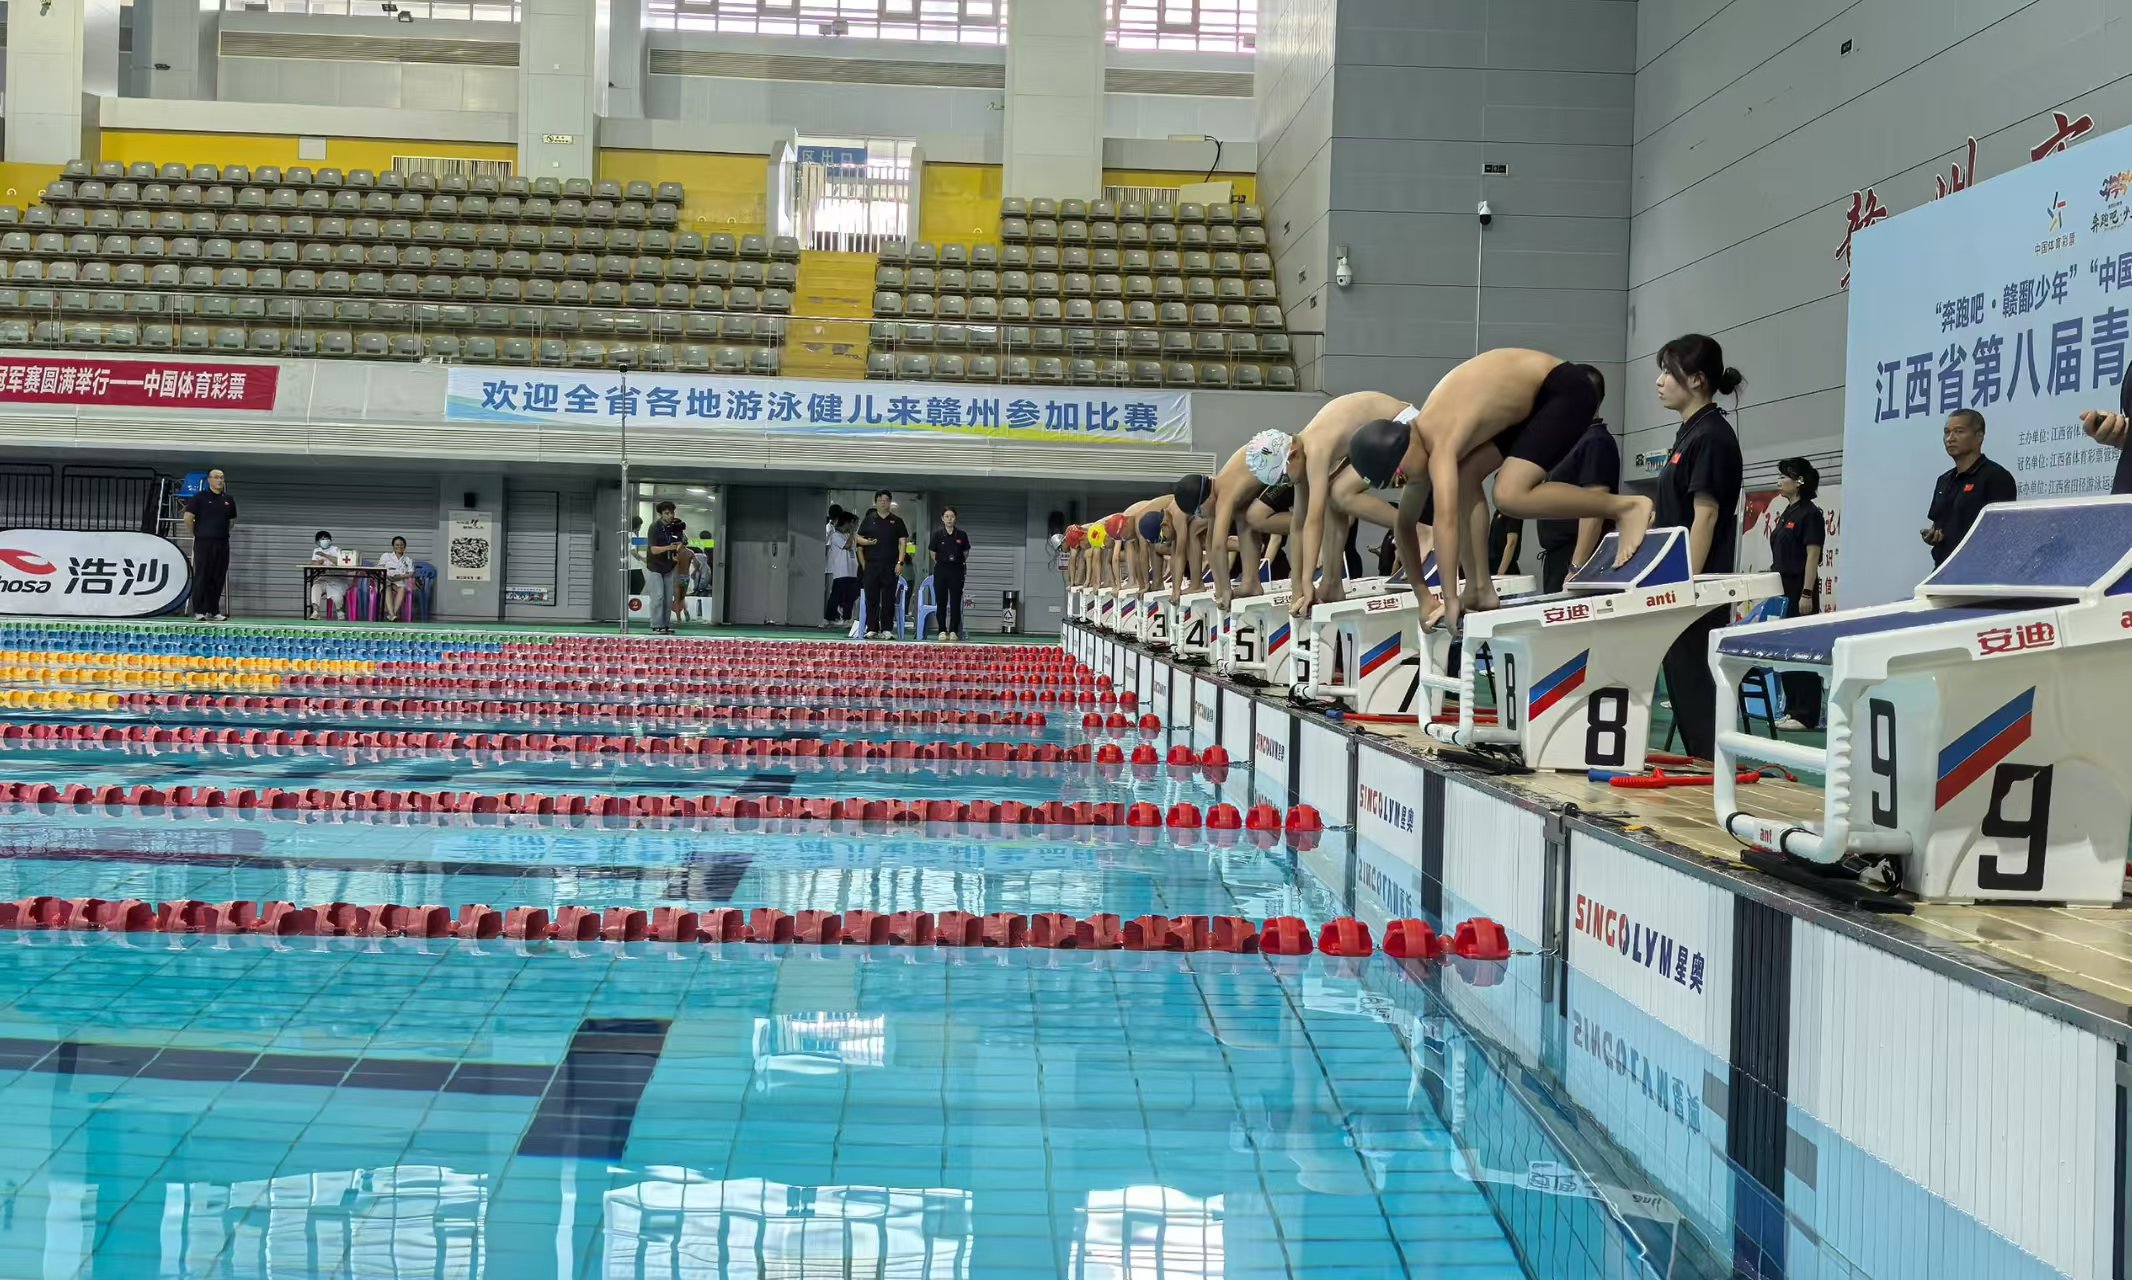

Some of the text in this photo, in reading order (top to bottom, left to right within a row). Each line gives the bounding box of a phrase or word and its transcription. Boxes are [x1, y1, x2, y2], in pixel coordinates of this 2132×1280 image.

[802, 149, 853, 165] 区出口
[2090, 205, 2132, 233] 奔跑吧·少
[2034, 231, 2076, 256] 中国体育彩票
[1874, 305, 2130, 423] 江西省第八届青
[481, 379, 1158, 433] 欢迎全省各地游泳健儿来赣州参加比赛
[64, 556, 169, 596] 浩沙
[1543, 603, 1590, 624] 安迪
[1646, 590, 1677, 607] anti
[1152, 614, 1166, 637] 3
[1186, 619, 1204, 648] 4
[1977, 622, 2056, 656] 安迪
[1236, 628, 1254, 662] 5
[1398, 657, 1421, 712] 7
[1504, 653, 1516, 731] 8
[1585, 687, 1630, 767] 8
[1869, 698, 1897, 828] 9
[1978, 763, 2053, 891] 9
